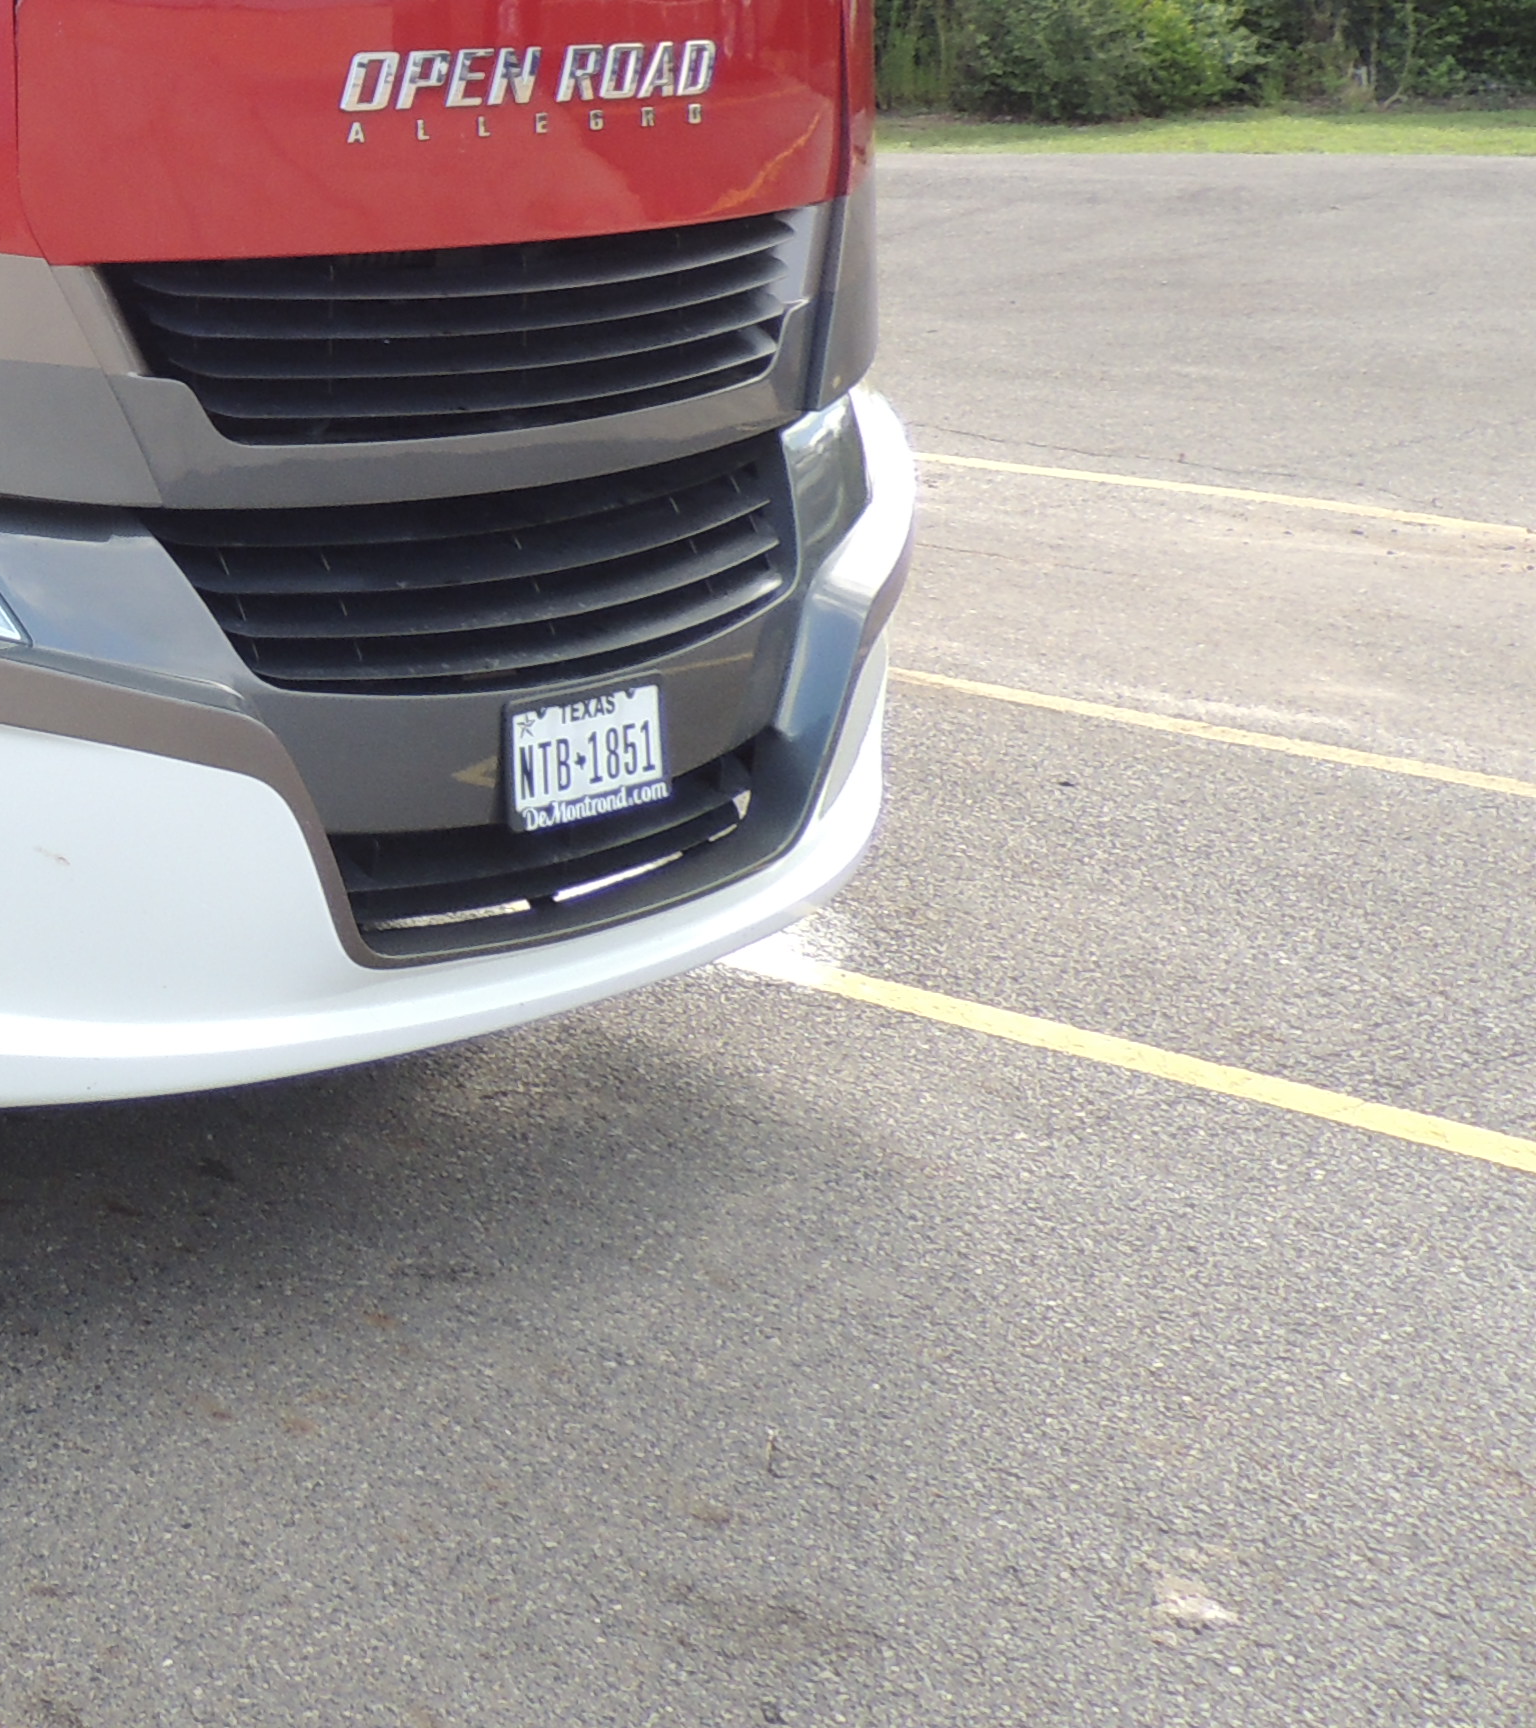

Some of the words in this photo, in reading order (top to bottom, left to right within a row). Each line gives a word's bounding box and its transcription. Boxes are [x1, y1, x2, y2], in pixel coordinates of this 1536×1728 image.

[339, 46, 542, 112] OPEN
[555, 39, 716, 103] ROAD
[346, 103, 703, 144] ALLEGRO
[559, 695, 616, 724] TEXAS
[521, 781, 669, 832] DeMontrond.com
